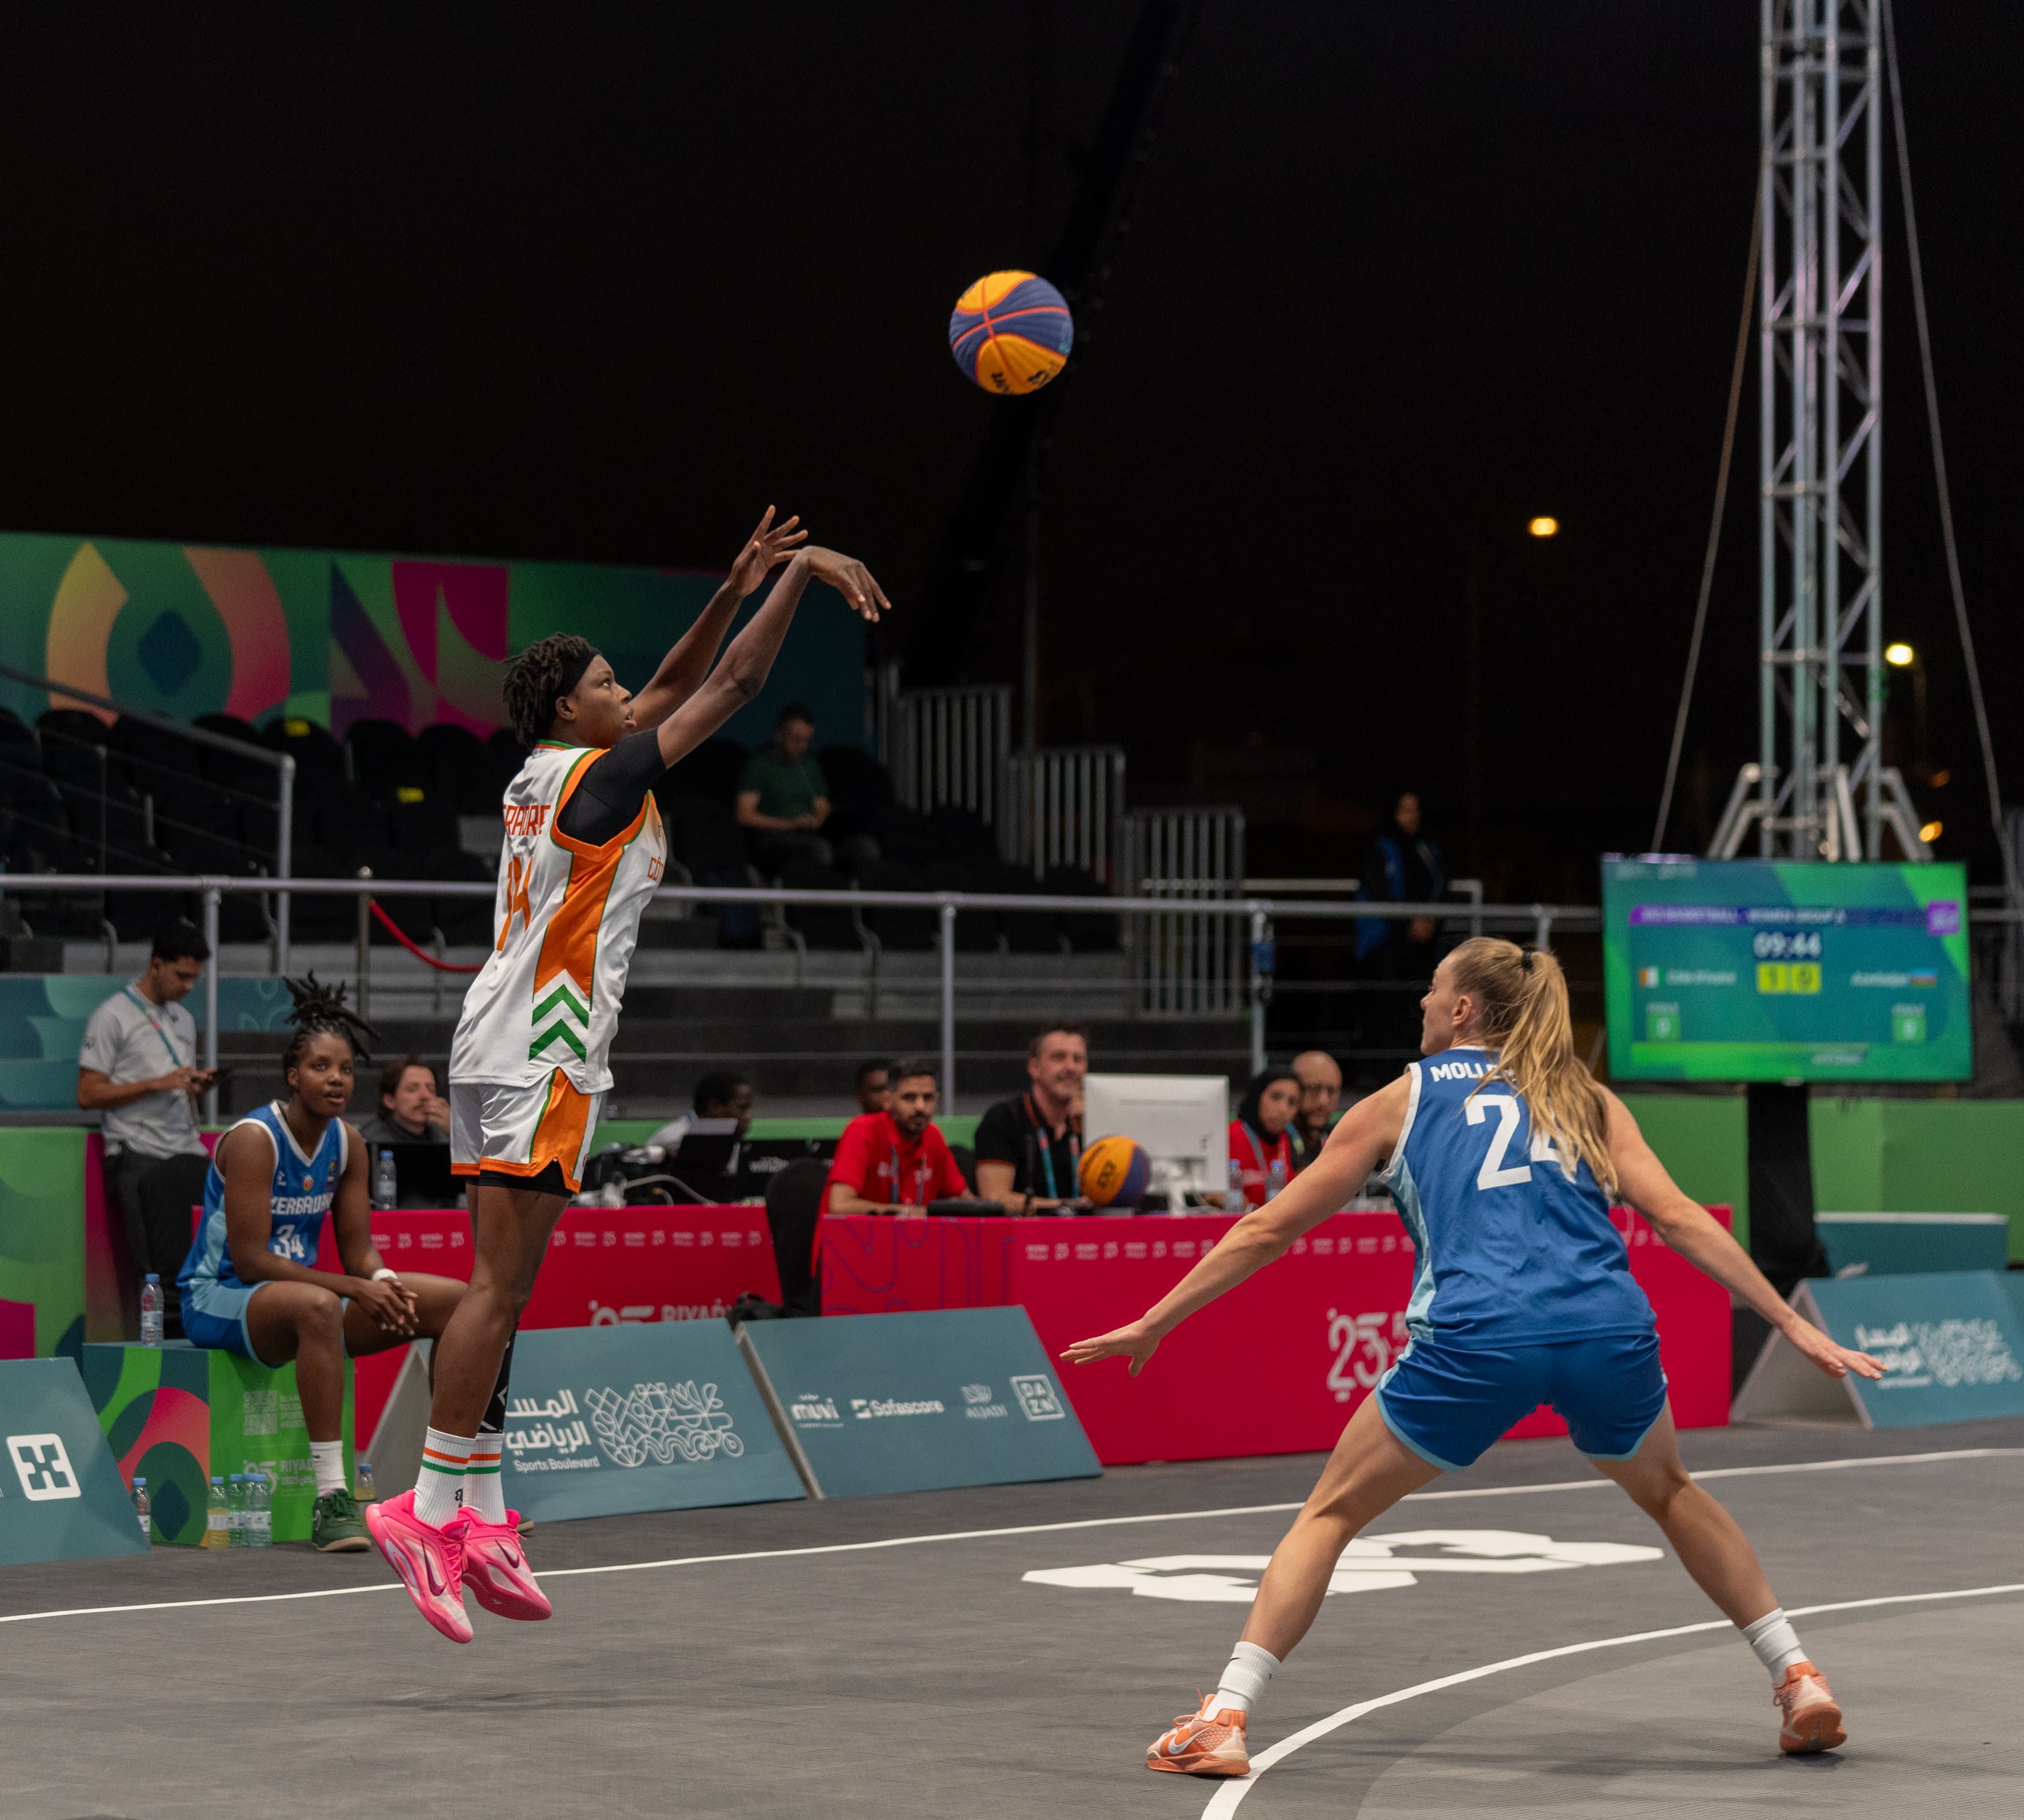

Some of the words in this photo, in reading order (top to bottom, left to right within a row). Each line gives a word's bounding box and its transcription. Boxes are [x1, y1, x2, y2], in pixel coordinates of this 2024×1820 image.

[503, 804, 551, 836] RAORE
[1754, 931, 1822, 959] 09:44
[271, 1192, 334, 1215] ZERBAIJAN
[274, 1224, 305, 1259] 34
[869, 1398, 944, 1417] Sofascore
[505, 1421, 592, 1456] الرياضي
[514, 1460, 549, 1473] Sports
[549, 1456, 600, 1471] Boulevard
